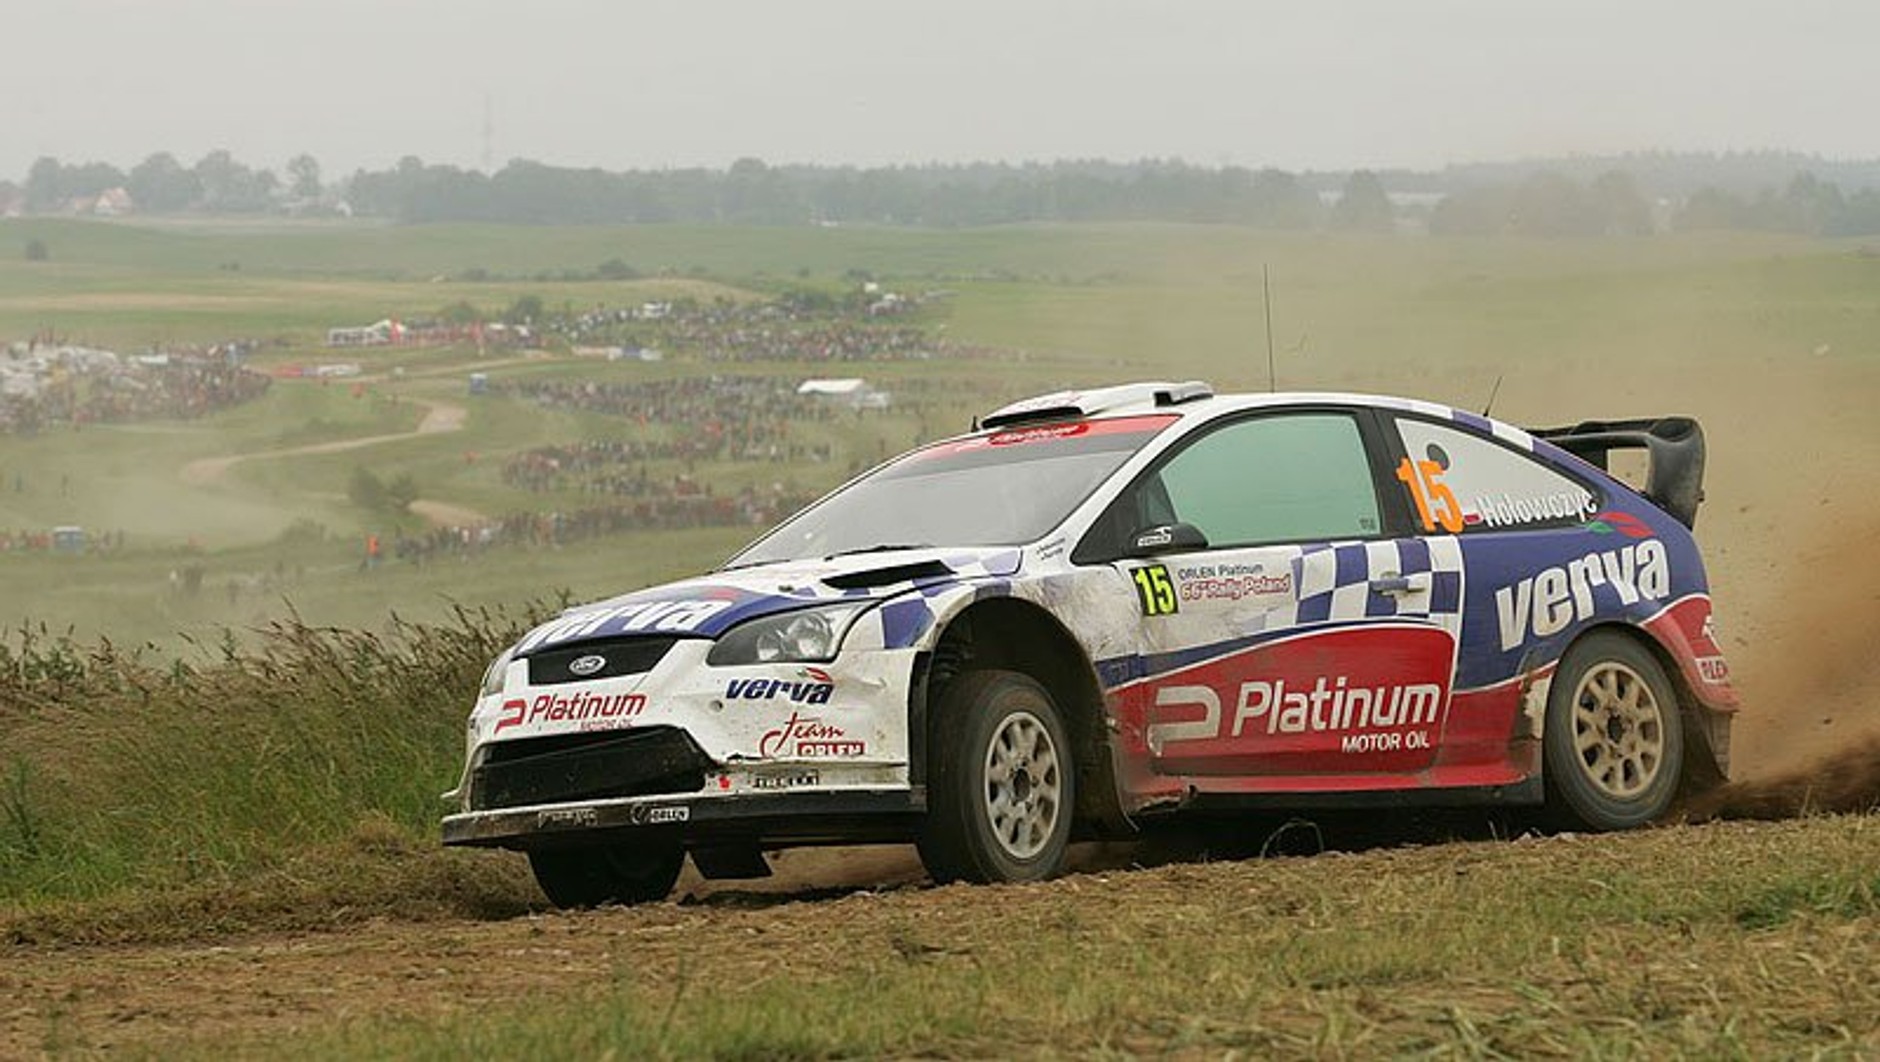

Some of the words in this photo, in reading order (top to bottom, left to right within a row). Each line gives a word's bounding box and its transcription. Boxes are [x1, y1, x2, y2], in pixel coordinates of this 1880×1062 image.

[1396, 457, 1463, 533] 15
[1135, 566, 1175, 615] 15
[1495, 538, 1670, 652] verva
[529, 692, 646, 723] Platinum
[726, 679, 834, 704] verva
[1231, 677, 1440, 737] Platinum
[1342, 733, 1400, 753] MOTOR
[1405, 731, 1430, 748] OIL
